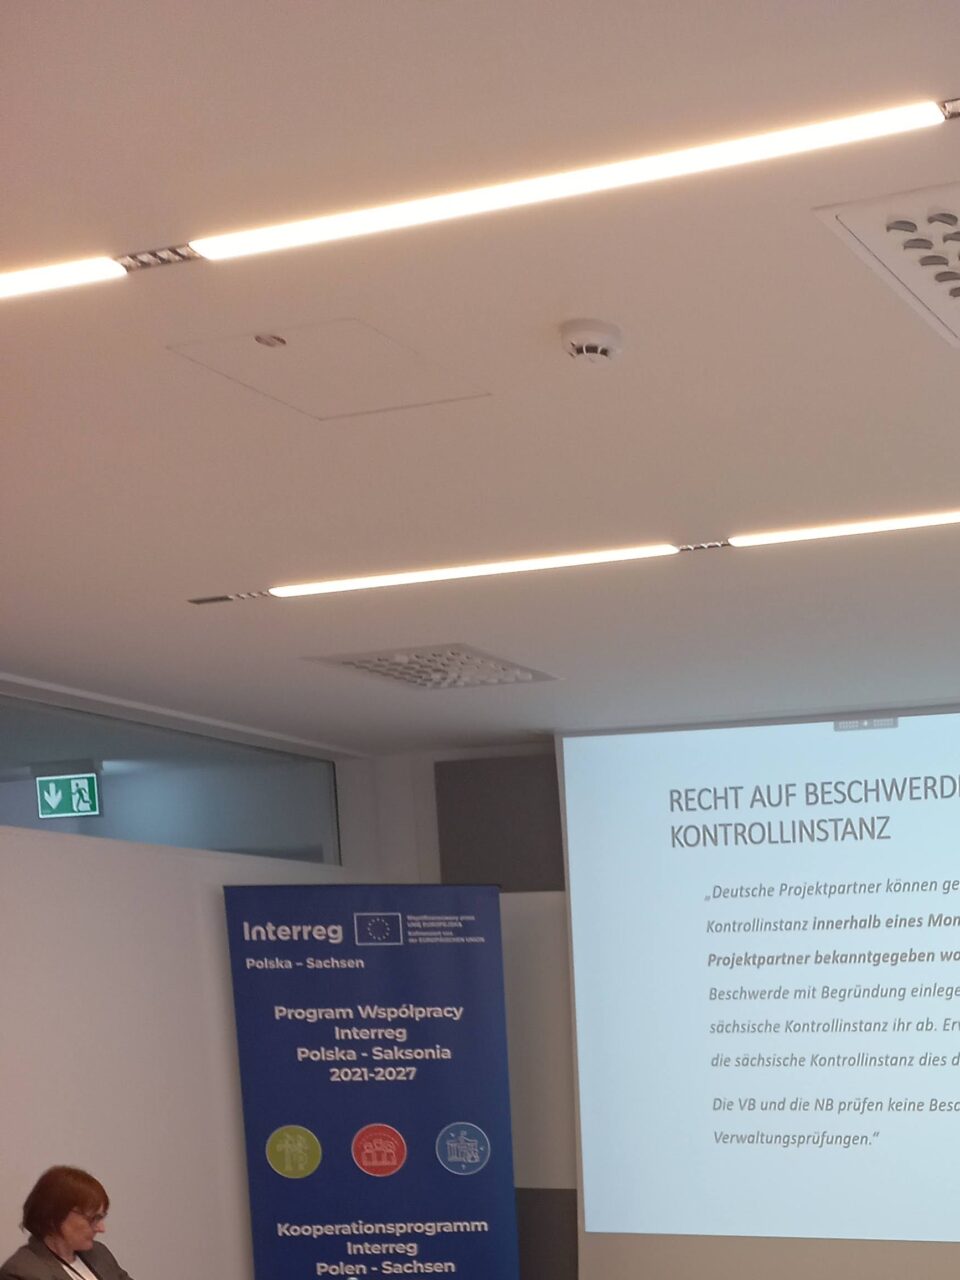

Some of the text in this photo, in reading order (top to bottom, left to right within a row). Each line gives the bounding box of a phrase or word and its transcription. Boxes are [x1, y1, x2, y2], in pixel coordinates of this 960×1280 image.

[669, 786, 743, 812] RECHT
[749, 783, 797, 808] AUF
[671, 816, 891, 848] KONTROLLINSTANZ
[779, 879, 882, 899] Projektpartner
[886, 878, 938, 893] können
[243, 921, 343, 944] Interreg
[706, 917, 808, 934] Kontrollinstanz
[812, 915, 881, 931] innerhalb
[885, 914, 923, 929] eines
[245, 958, 293, 969] Polska
[306, 957, 364, 969] Sachsen
[708, 952, 811, 969] Projektpartner
[814, 949, 935, 967] bekanntgegeben
[709, 986, 790, 1001] Beschwerde
[793, 986, 817, 999] mit
[821, 984, 906, 1002] Begründung
[274, 1004, 464, 1022] Program Współpracy
[335, 1026, 407, 1042] Interreg
[709, 1020, 781, 1034] sächsische
[784, 1019, 888, 1033] Kontrollinstanz
[892, 1018, 912, 1032] ihr
[916, 1018, 937, 1032] ab.
[297, 1046, 356, 1061] Polska
[372, 1045, 452, 1060] Saksonia
[711, 1054, 731, 1067] die
[735, 1053, 806, 1068] sächsische
[810, 1052, 914, 1067] Kontrollinstanz
[919, 1052, 947, 1067] dies
[330, 1067, 416, 1082] 2021-2027
[712, 1098, 734, 1112] Die
[738, 1098, 756, 1111] VB
[761, 1098, 786, 1112] und
[789, 1098, 810, 1112] die
[814, 1098, 834, 1111] NB
[838, 1098, 884, 1114] prüfen
[888, 1098, 924, 1112] keine
[277, 1220, 489, 1238] Kooperationsprogramm
[347, 1242, 418, 1256] Interreg
[316, 1262, 367, 1275] Polen
[382, 1260, 456, 1274] Sachsen
